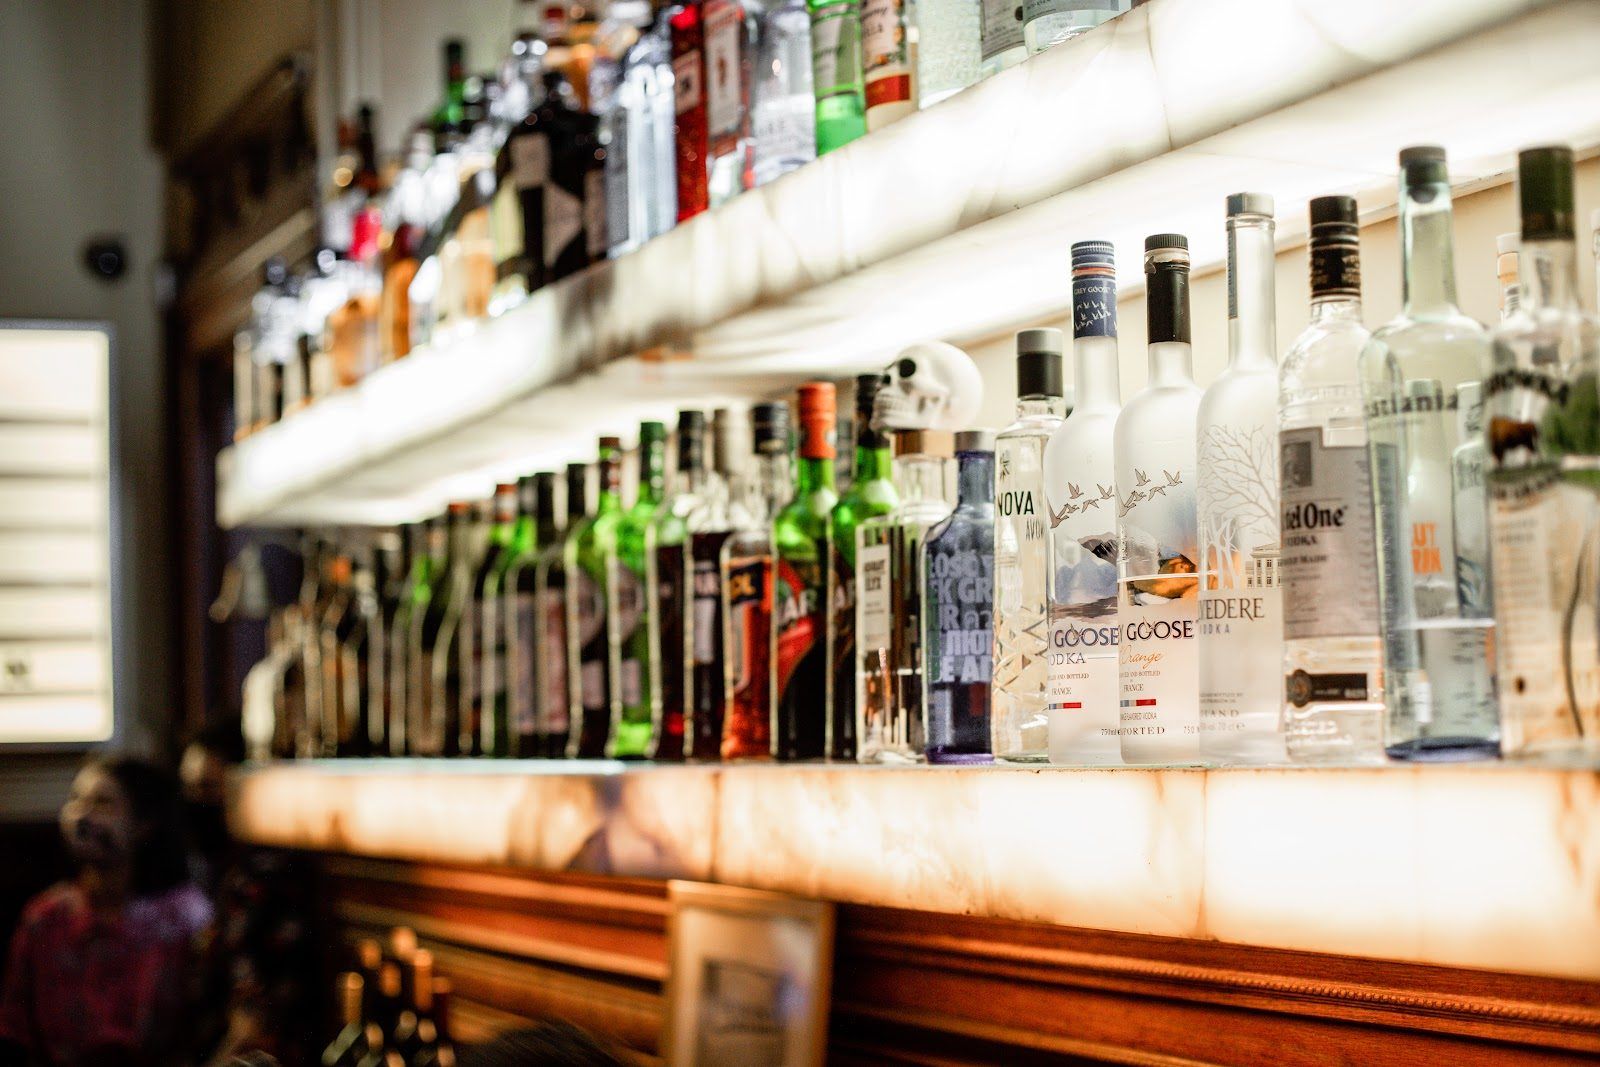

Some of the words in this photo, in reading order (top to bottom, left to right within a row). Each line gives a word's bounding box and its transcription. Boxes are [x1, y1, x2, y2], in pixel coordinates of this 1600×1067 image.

[1054, 627, 1118, 648] GOOSE
[1126, 620, 1194, 641] GOOSE
[1123, 684, 1144, 692] FRANCE
